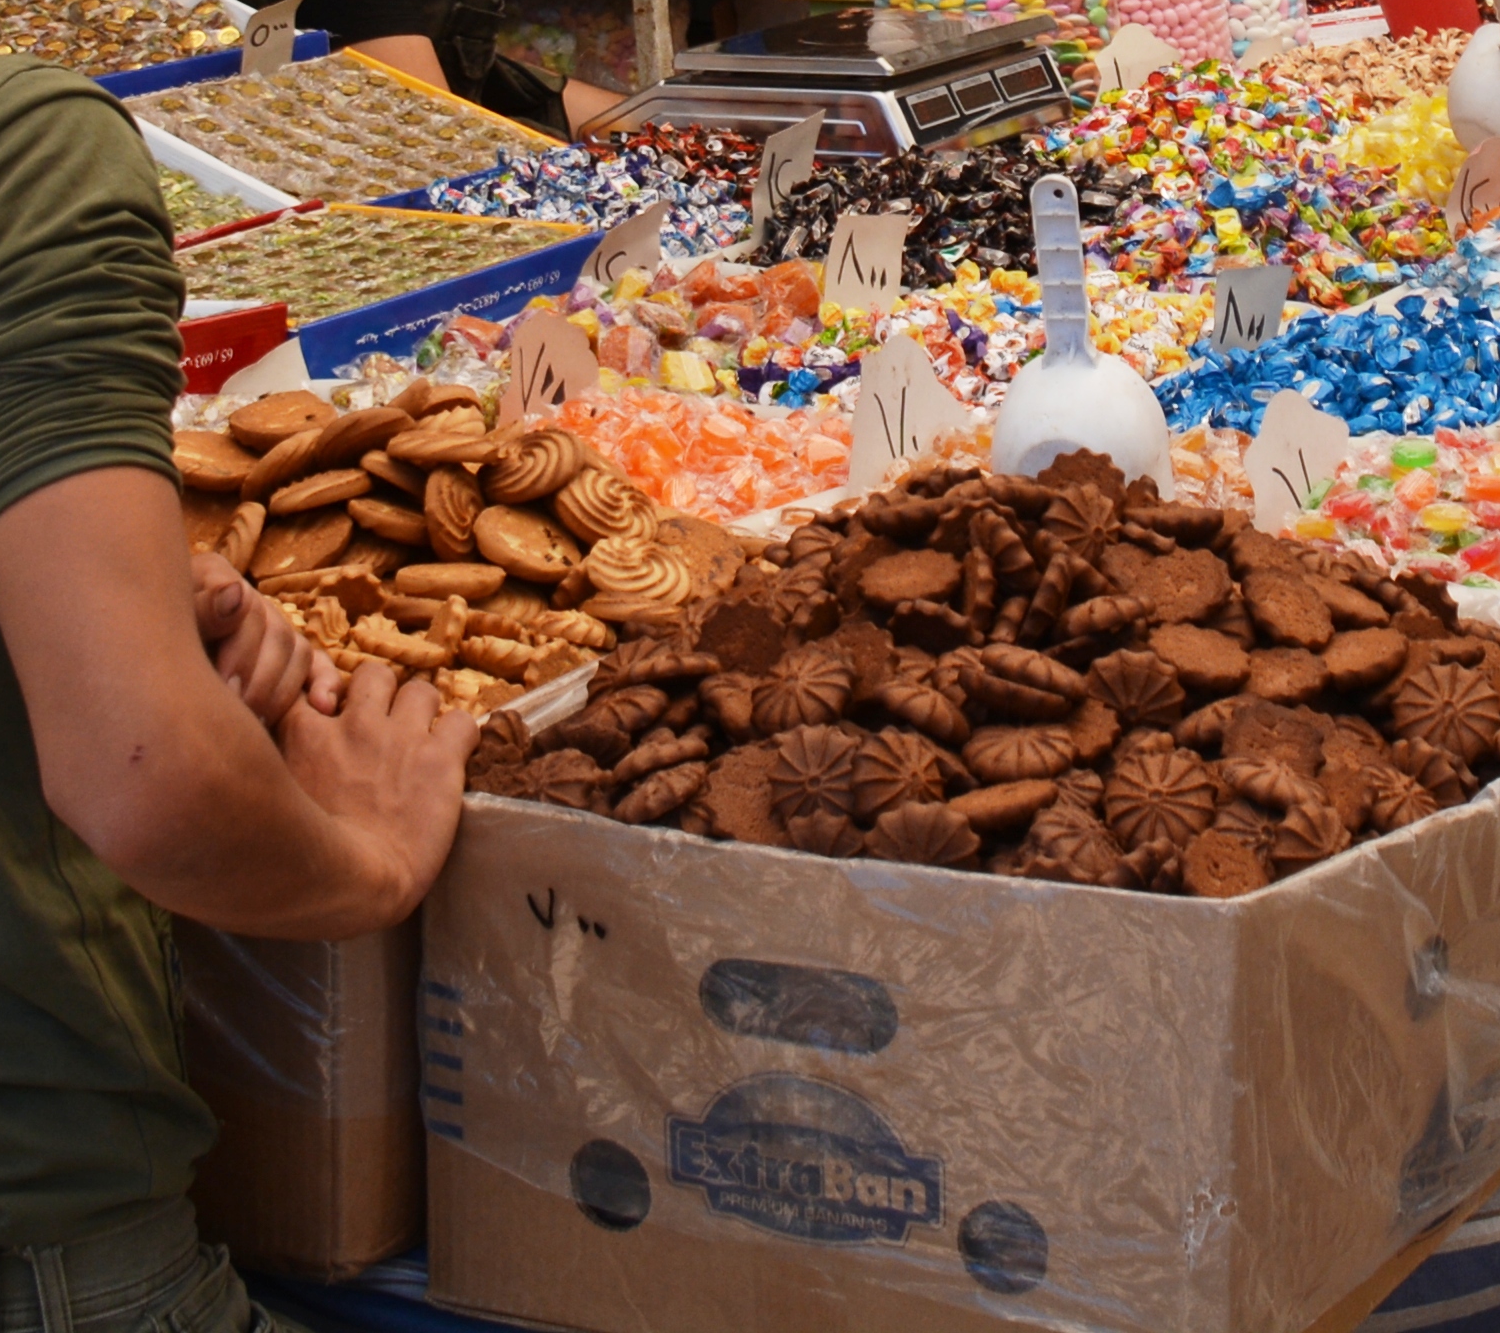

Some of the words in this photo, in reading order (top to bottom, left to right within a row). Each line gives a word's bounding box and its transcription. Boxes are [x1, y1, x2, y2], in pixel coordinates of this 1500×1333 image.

[677, 1129, 929, 1214] ExtraBan
[721, 1190, 802, 1222] PREMIUM
[804, 1202, 889, 1232] BANANAS
